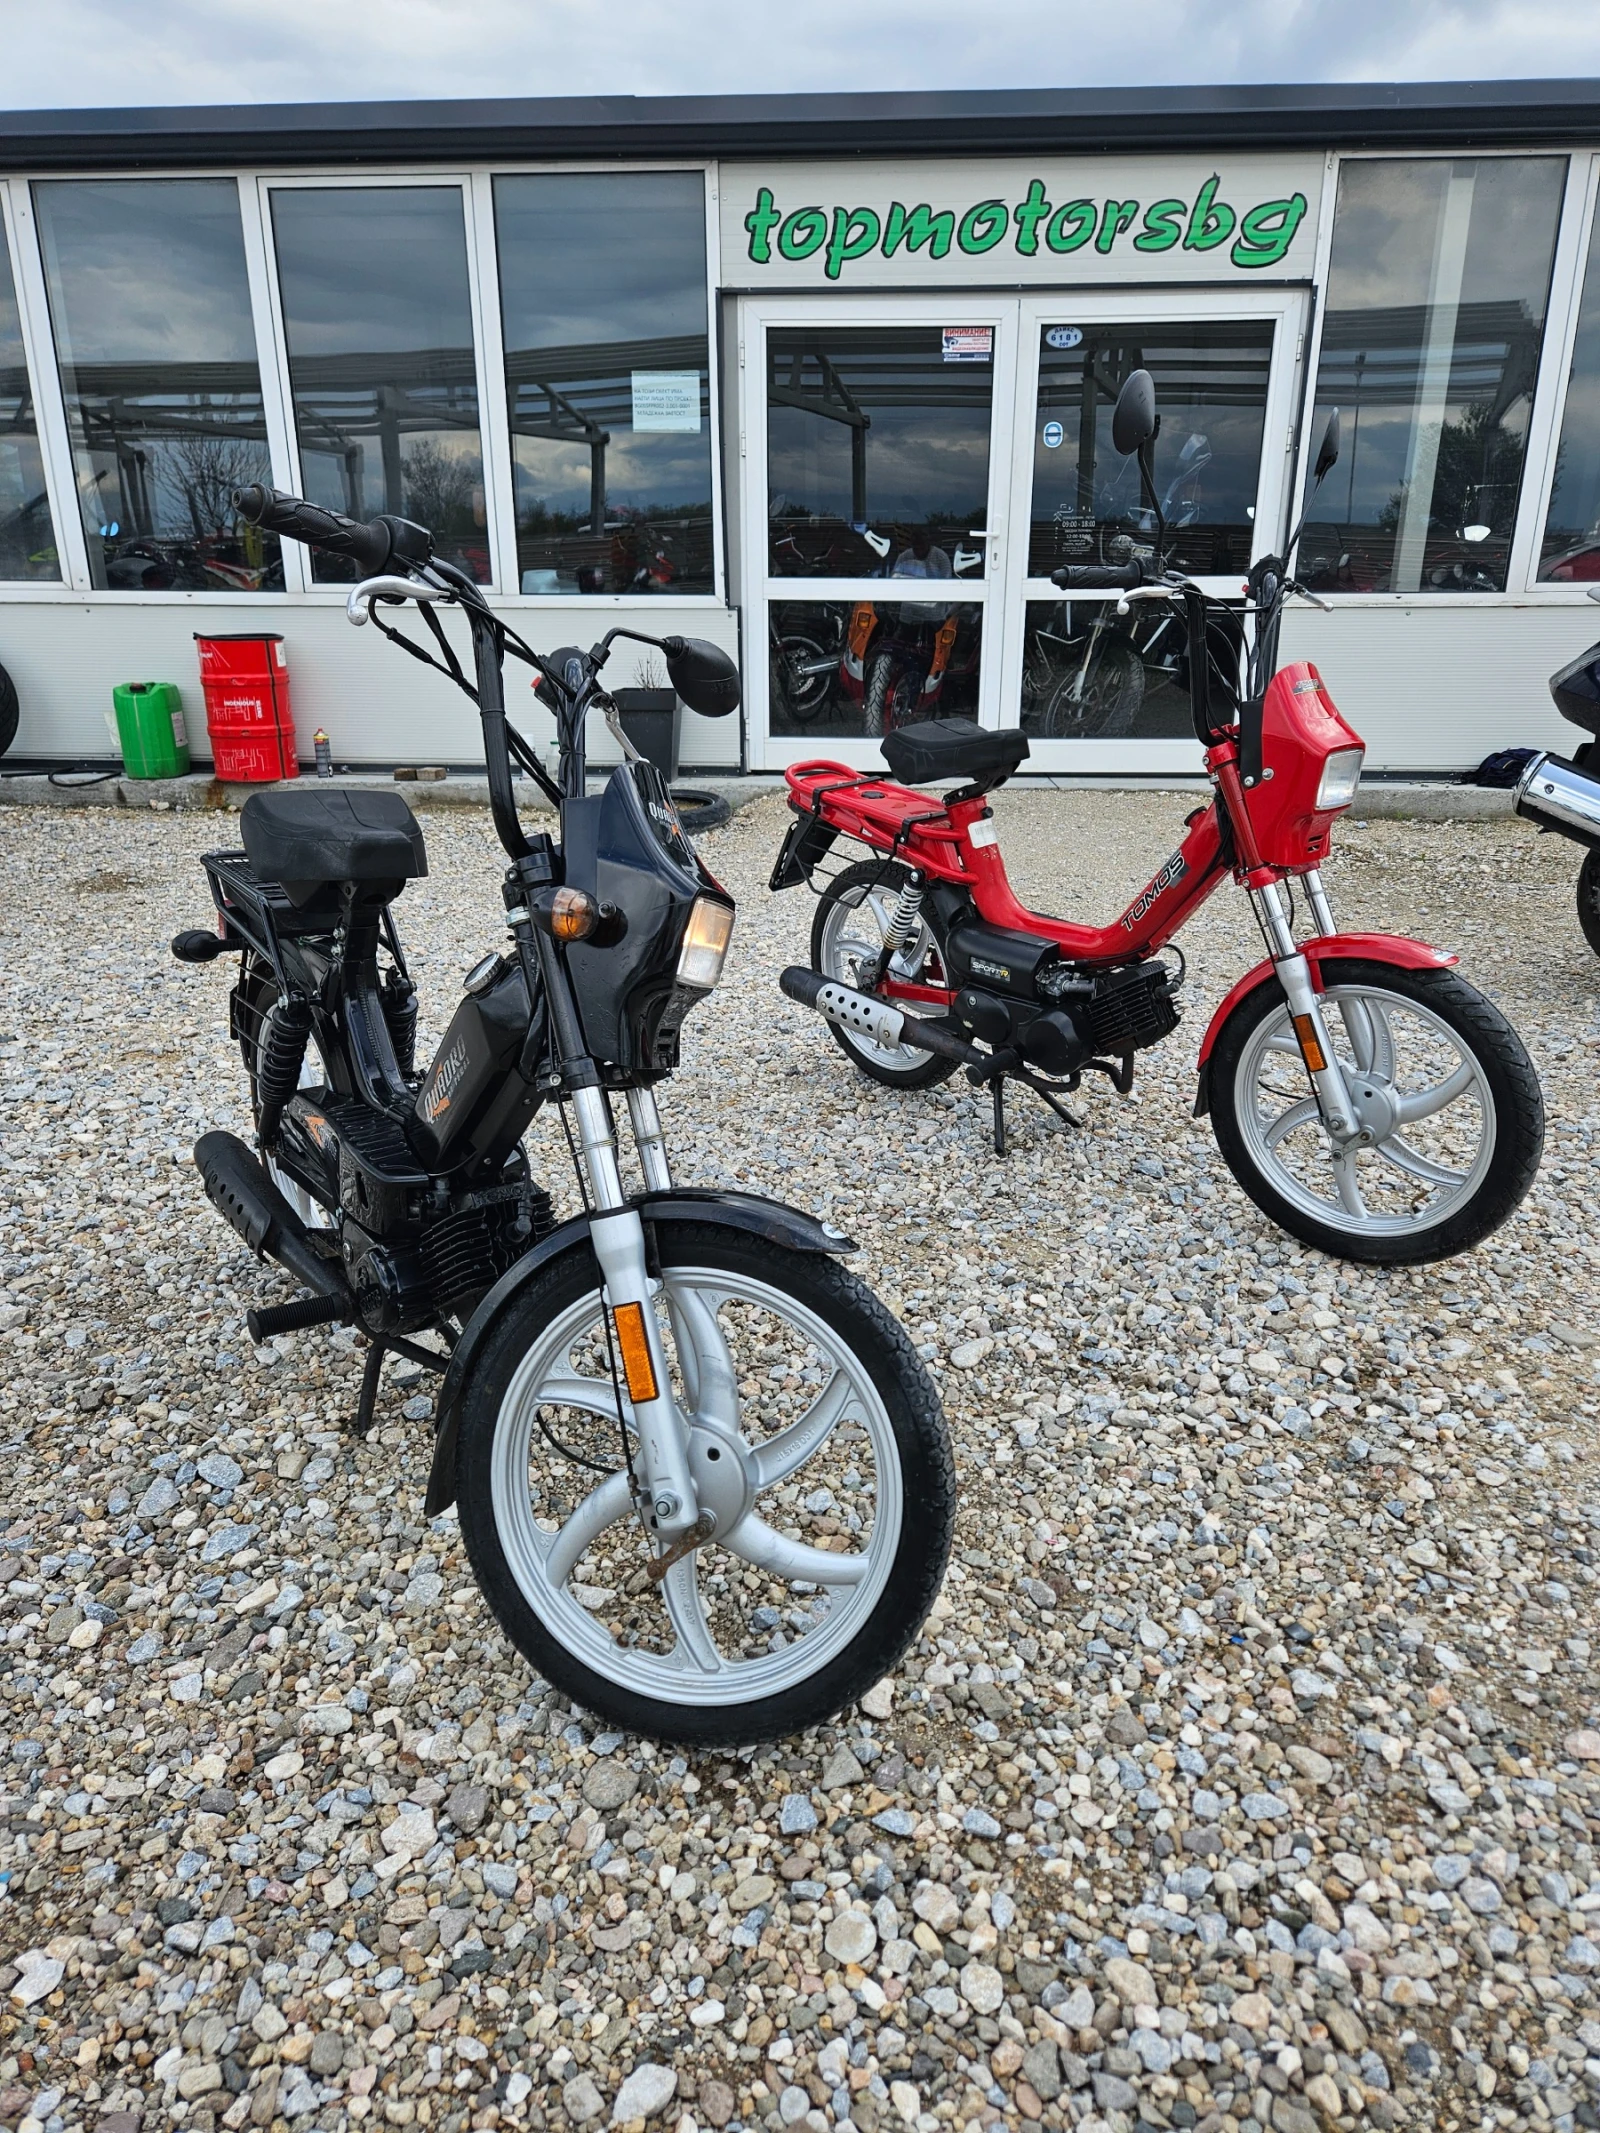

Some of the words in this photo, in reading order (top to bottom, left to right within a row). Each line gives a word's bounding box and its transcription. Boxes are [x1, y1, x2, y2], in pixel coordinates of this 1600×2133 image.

[745, 173, 1308, 280] topmotorsbg
[1121, 849, 1185, 931] TOMOS
[424, 1033, 466, 1125] QUADRO
